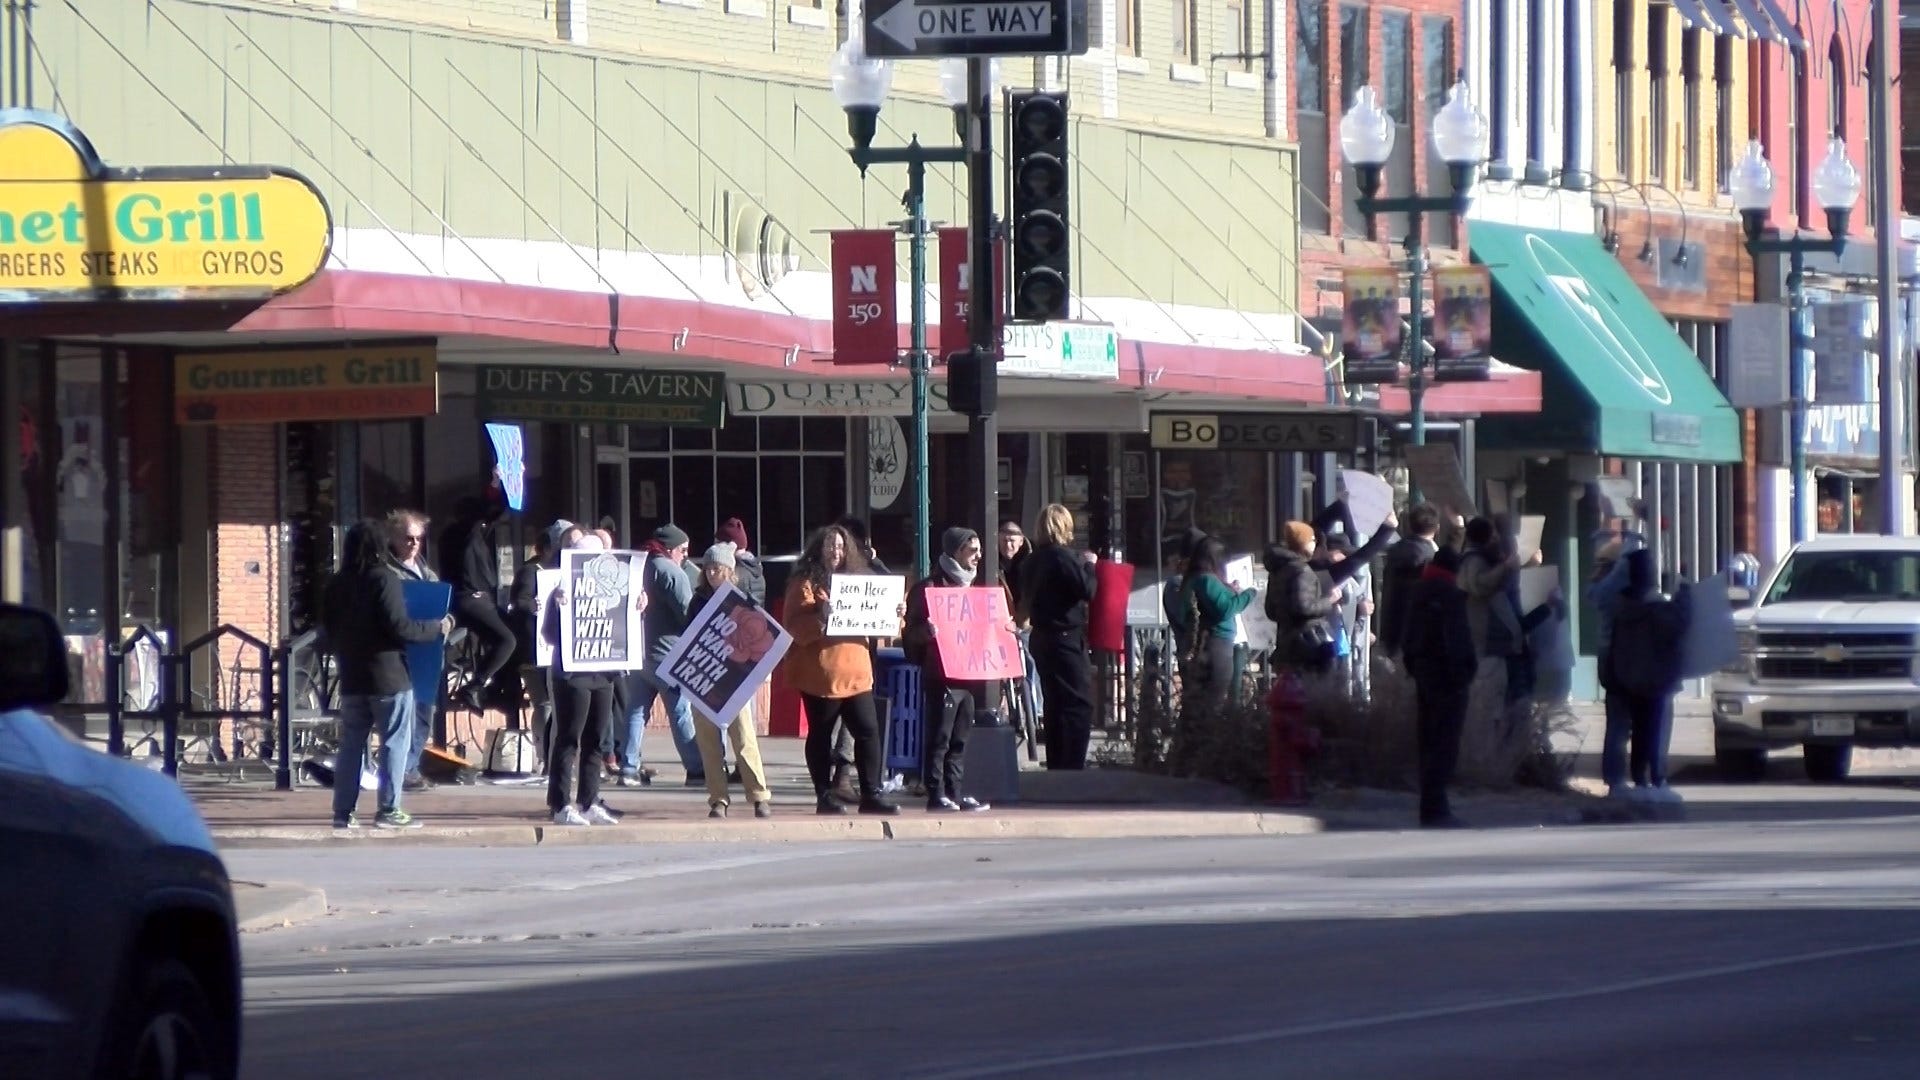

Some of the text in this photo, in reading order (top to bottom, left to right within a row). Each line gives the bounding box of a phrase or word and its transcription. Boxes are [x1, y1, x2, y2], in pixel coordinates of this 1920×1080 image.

[918, 6, 1046, 34] ONE WAY
[115, 191, 265, 245] Grill
[0, 252, 66, 276] RGERS
[80, 251, 159, 276] STEAKS
[203, 250, 284, 276] GYROS
[850, 265, 877, 292] N
[848, 303, 882, 325] 150
[187, 357, 422, 390] Gourmet Grill
[485, 368, 717, 399] DUFFY'S TAVERN
[737, 382, 949, 412] DUFFYS
[1171, 420, 1337, 443] BODEGA'S
[871, 485, 898, 496] UDIO
[574, 577, 596, 597] NO
[864, 581, 888, 597] Here
[575, 598, 607, 618] WAR
[575, 618, 613, 638] WITH
[709, 611, 738, 636] NO
[574, 639, 612, 659] IRAN
[698, 627, 735, 662] WAR
[685, 643, 729, 682] WITH
[951, 646, 1009, 673] AR!
[673, 660, 716, 697] IRAN
